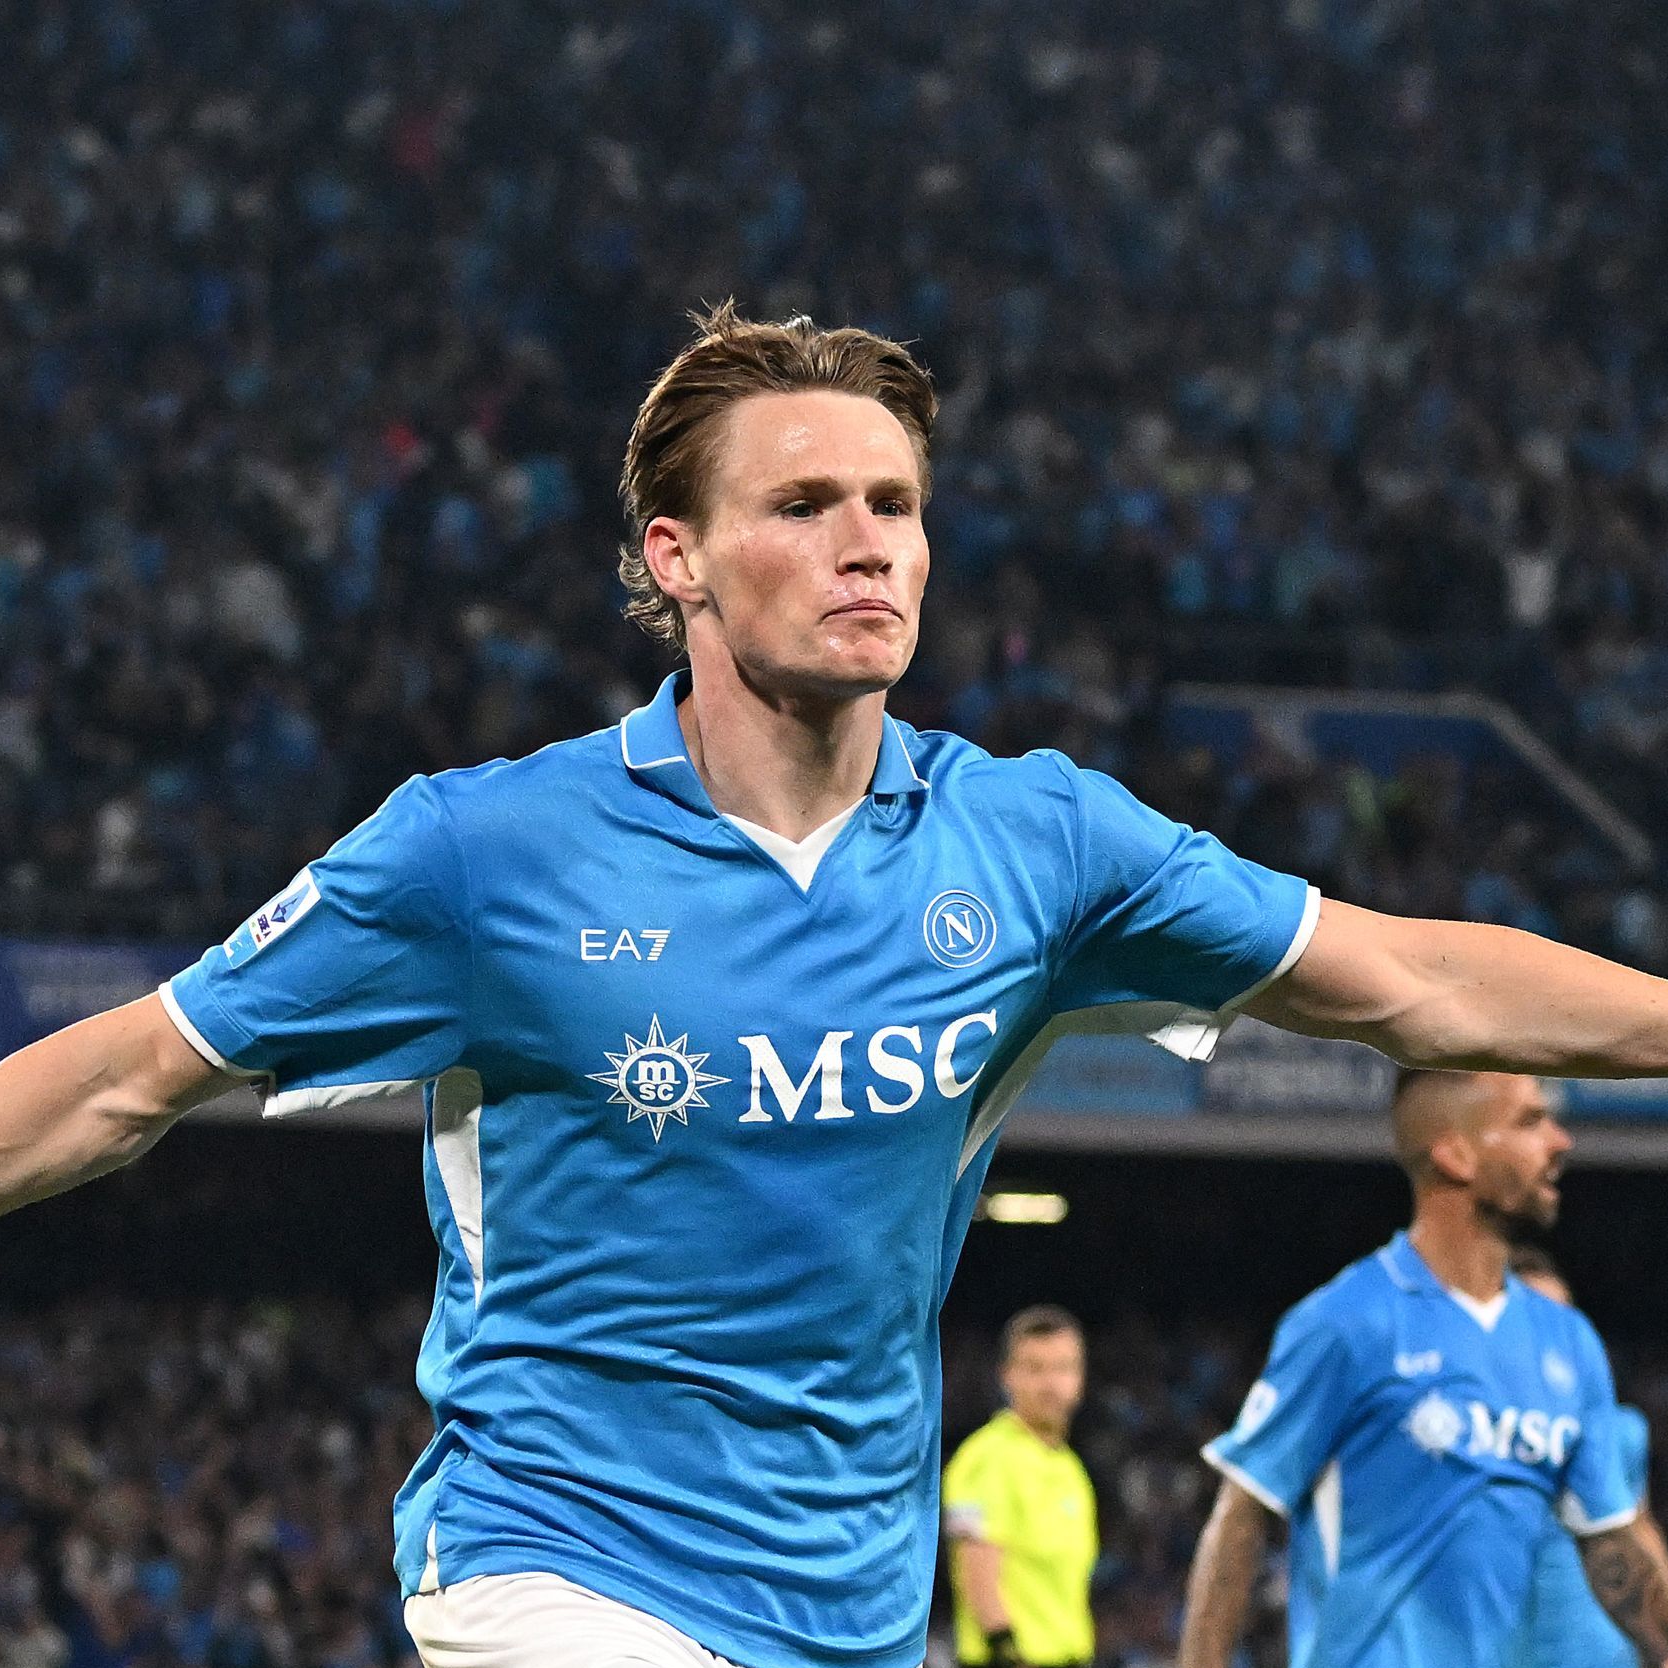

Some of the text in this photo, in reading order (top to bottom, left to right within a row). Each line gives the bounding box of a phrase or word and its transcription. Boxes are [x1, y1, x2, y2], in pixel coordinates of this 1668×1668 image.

[580, 928, 671, 962] EA7
[942, 910, 976, 949] N
[738, 1008, 998, 1123] MSC
[1467, 1401, 1580, 1468] MSC
